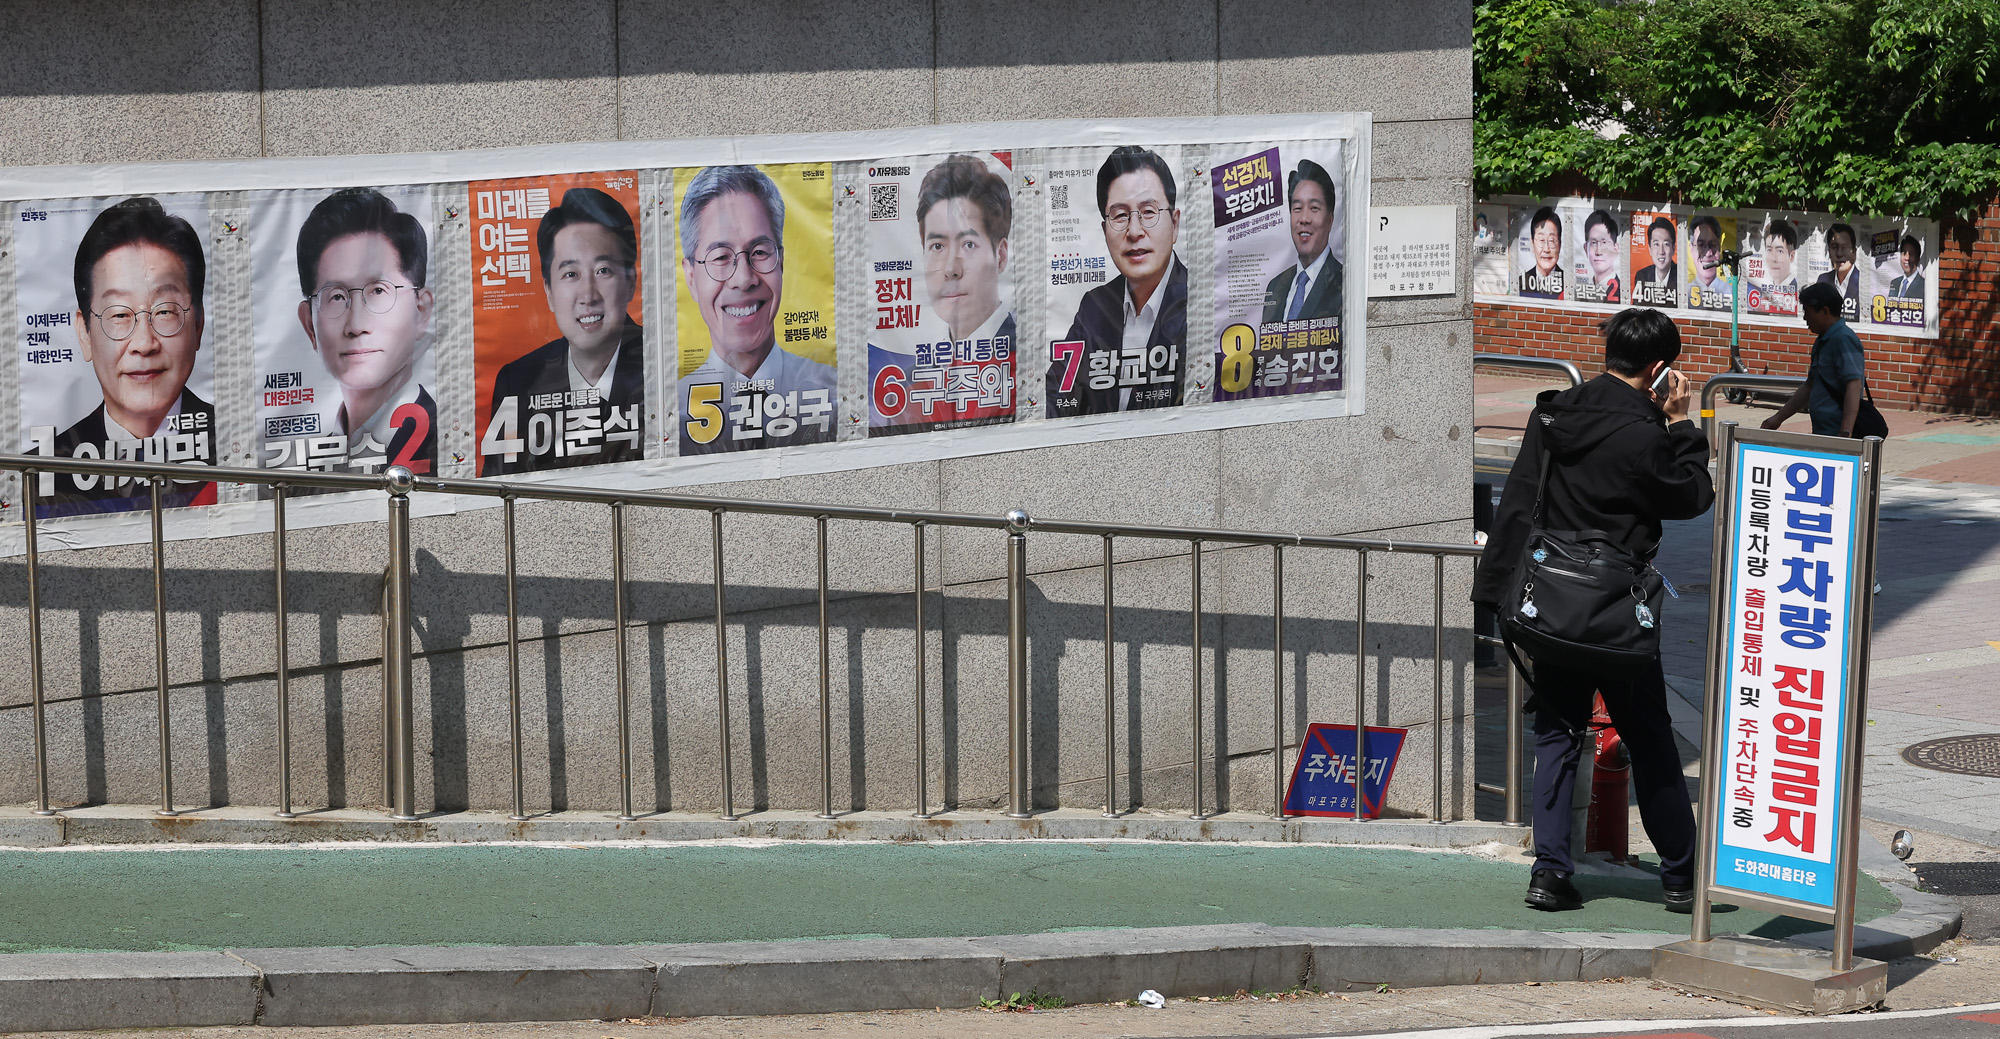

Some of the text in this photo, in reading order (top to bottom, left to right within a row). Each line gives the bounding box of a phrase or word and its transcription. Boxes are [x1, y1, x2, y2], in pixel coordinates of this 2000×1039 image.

[876, 165, 911, 178] 자유통일당
[1065, 169, 1081, 178] 이유가
[1081, 168, 1094, 177] 있다!
[1222, 155, 1272, 192] 선경제,
[477, 187, 551, 221] 미래를
[1225, 181, 1275, 218] 후정치!
[21, 211, 48, 222] 민주당
[478, 222, 529, 253] 여는
[479, 253, 531, 287] 선택
[873, 260, 913, 272] 광화문정신
[1051, 257, 1106, 271] 부정선거 척결로
[1748, 259, 1763, 268] 정치
[1050, 270, 1106, 286] 청년에게 미래를
[1528, 275, 1563, 293] 이재명
[875, 277, 913, 303] 정치
[1575, 278, 1619, 302] 김문수 2
[1631, 280, 1643, 303] 4
[1643, 287, 1677, 305] 이준석
[1690, 286, 1733, 309] 5 권영국
[1748, 289, 1760, 308] 6
[26, 312, 71, 328] 이제부터
[783, 310, 820, 326] 갈아엎자!
[875, 304, 921, 331] 교체!
[1872, 294, 1886, 322] 8
[1890, 309, 1923, 324] 송진호
[783, 325, 828, 343] 불평등 세상
[1260, 322, 1288, 334] 실천하는
[1288, 320, 1309, 332] 준비된
[1309, 328, 1340, 347] 해결사
[26, 331, 50, 347] 진짜
[27, 348, 74, 365] 대한민국
[1051, 340, 1179, 393] 7 황교안
[1220, 323, 1339, 393] 8 무소속 송진호
[264, 371, 302, 389] 새롭게
[730, 378, 775, 393] 진보대통령
[872, 362, 1015, 418] 6 구주와
[264, 387, 314, 407] 대한민국
[528, 387, 601, 411] 새로운 대통령
[1055, 398, 1079, 409] 무소속
[1134, 387, 1172, 402] 전 국무총리
[166, 411, 208, 431] 지금은
[686, 381, 832, 445] 5 권영국
[268, 416, 317, 435] 정정당당
[480, 395, 640, 463] 4 이준석
[389, 402, 431, 474] 2
[29, 425, 210, 497] 1 이재명
[1747, 466, 1772, 578] 미등록차량
[1740, 588, 1766, 677] 출입통제
[1763, 462, 1836, 854] 외부차량 진입금지
[1739, 686, 1760, 708] 및
[1303, 753, 1388, 786] 주차금지
[1734, 858, 1817, 887] 도화현대홈타운
